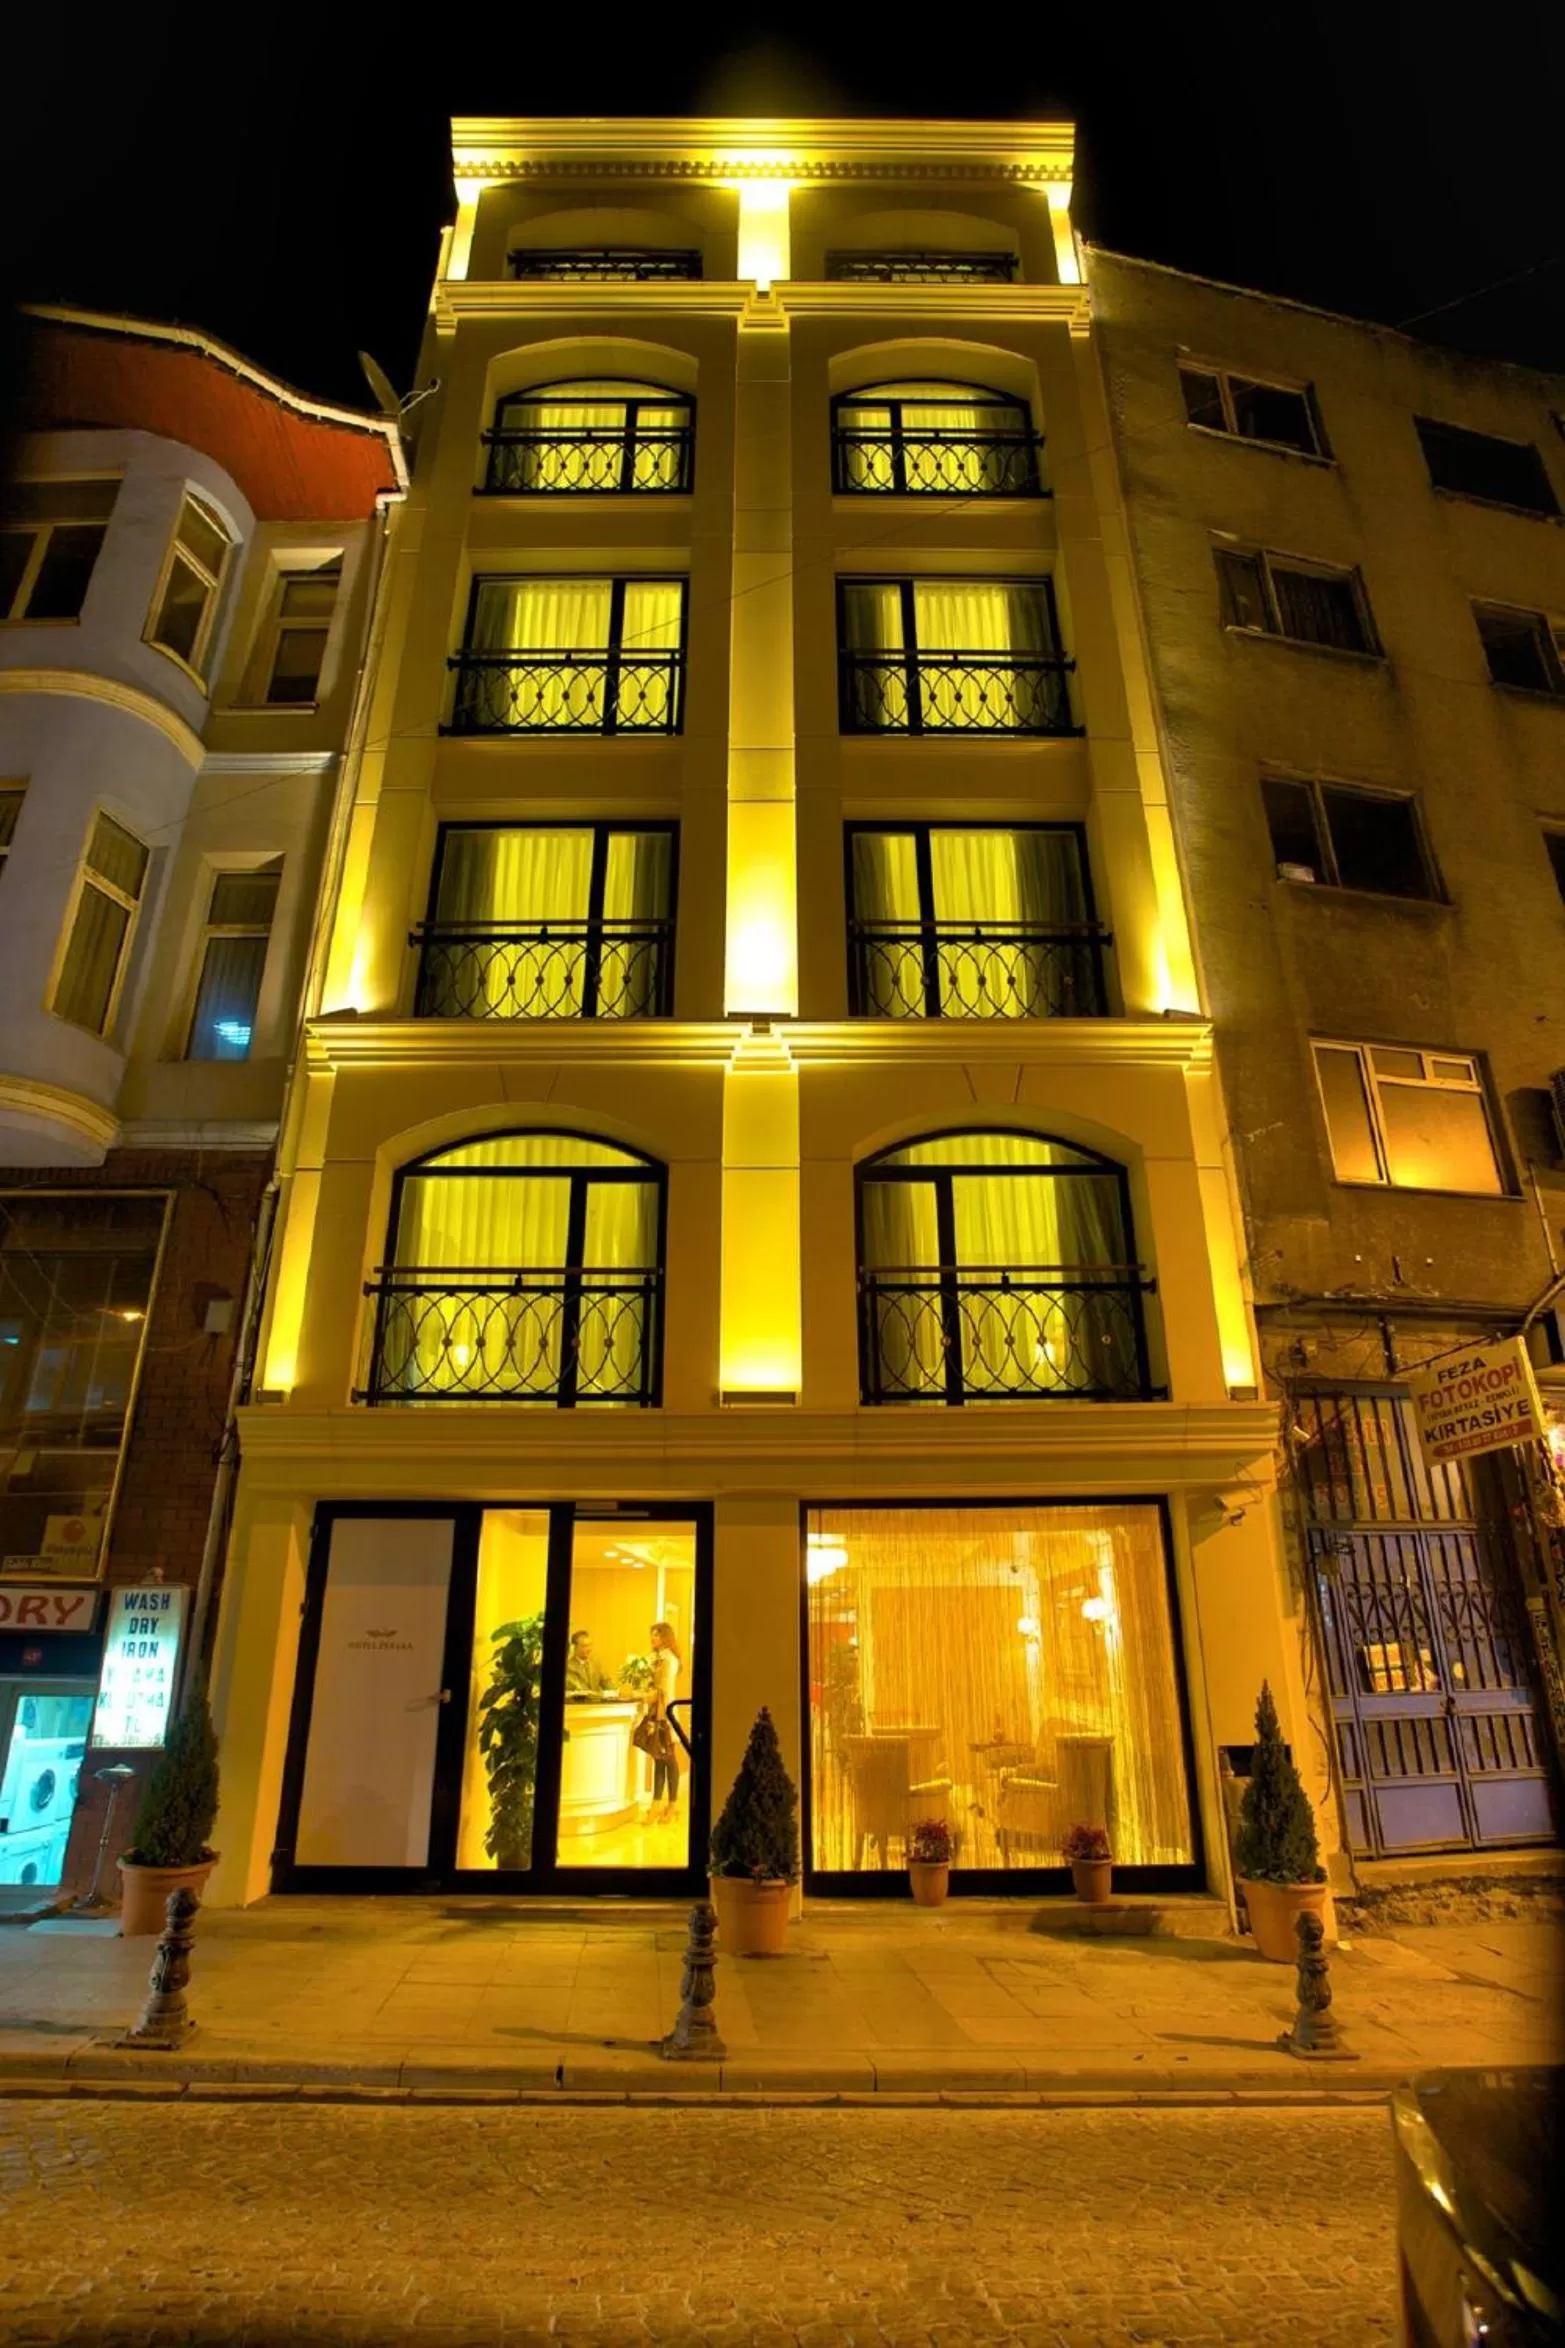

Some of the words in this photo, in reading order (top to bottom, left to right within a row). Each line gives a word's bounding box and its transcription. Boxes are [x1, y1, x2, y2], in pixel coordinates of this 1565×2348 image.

[1437, 1356, 1487, 1384] FEZA
[1418, 1356, 1522, 1413] FOTOKOPİ
[1424, 1399, 1531, 1443] KIRTASİYE
[124, 1592, 171, 1611] WASH
[128, 1617, 160, 1635] DRY
[121, 1641, 160, 1659] IRON
